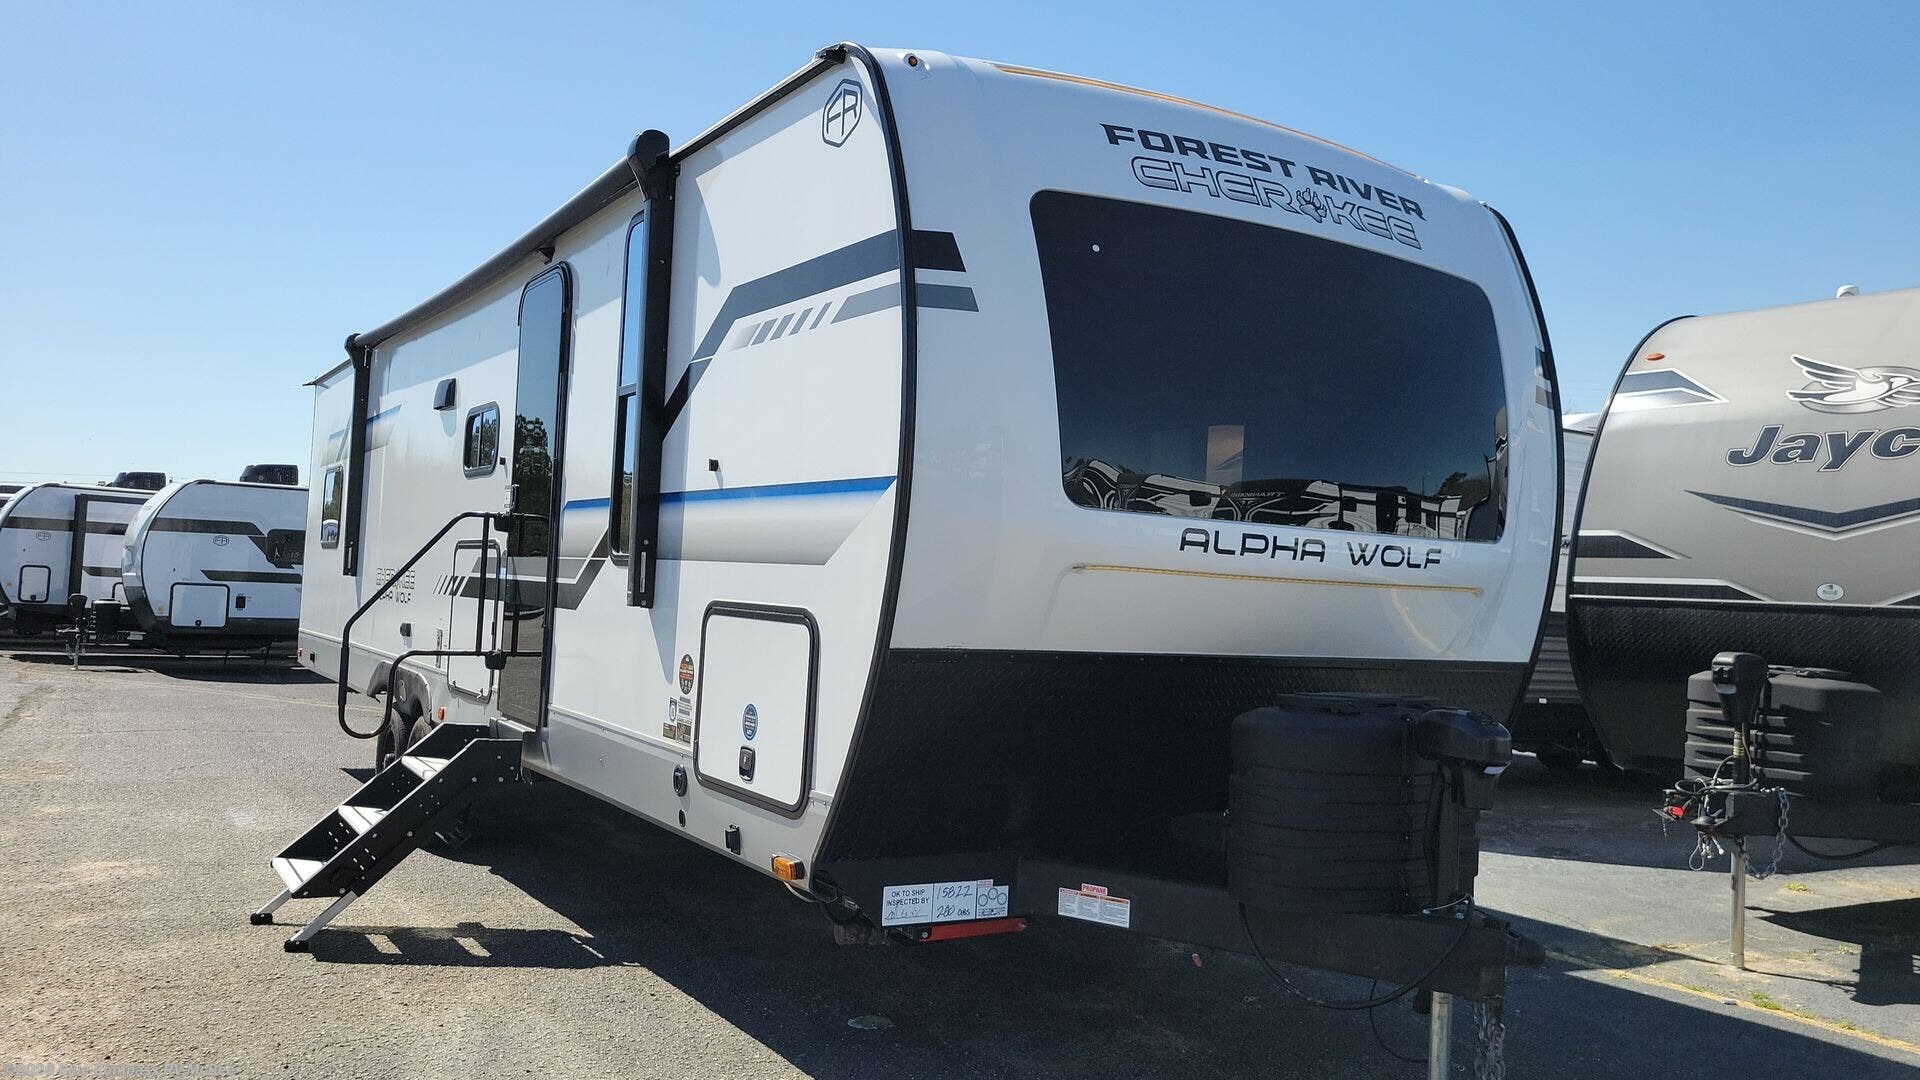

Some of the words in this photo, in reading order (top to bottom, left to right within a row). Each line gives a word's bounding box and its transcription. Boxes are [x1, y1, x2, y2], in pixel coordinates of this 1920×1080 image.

[1100, 123, 1296, 179] FOREST
[1305, 164, 1428, 221] RIVER
[1726, 424, 1920, 472] Jayc
[1179, 527, 1326, 562] ALPHA
[1346, 541, 1442, 569] WOLF
[902, 889, 911, 897] TO
[911, 888, 925, 896] SHIP
[1083, 885, 1106, 894] PROPANE
[887, 898, 920, 907] INSPECTED
